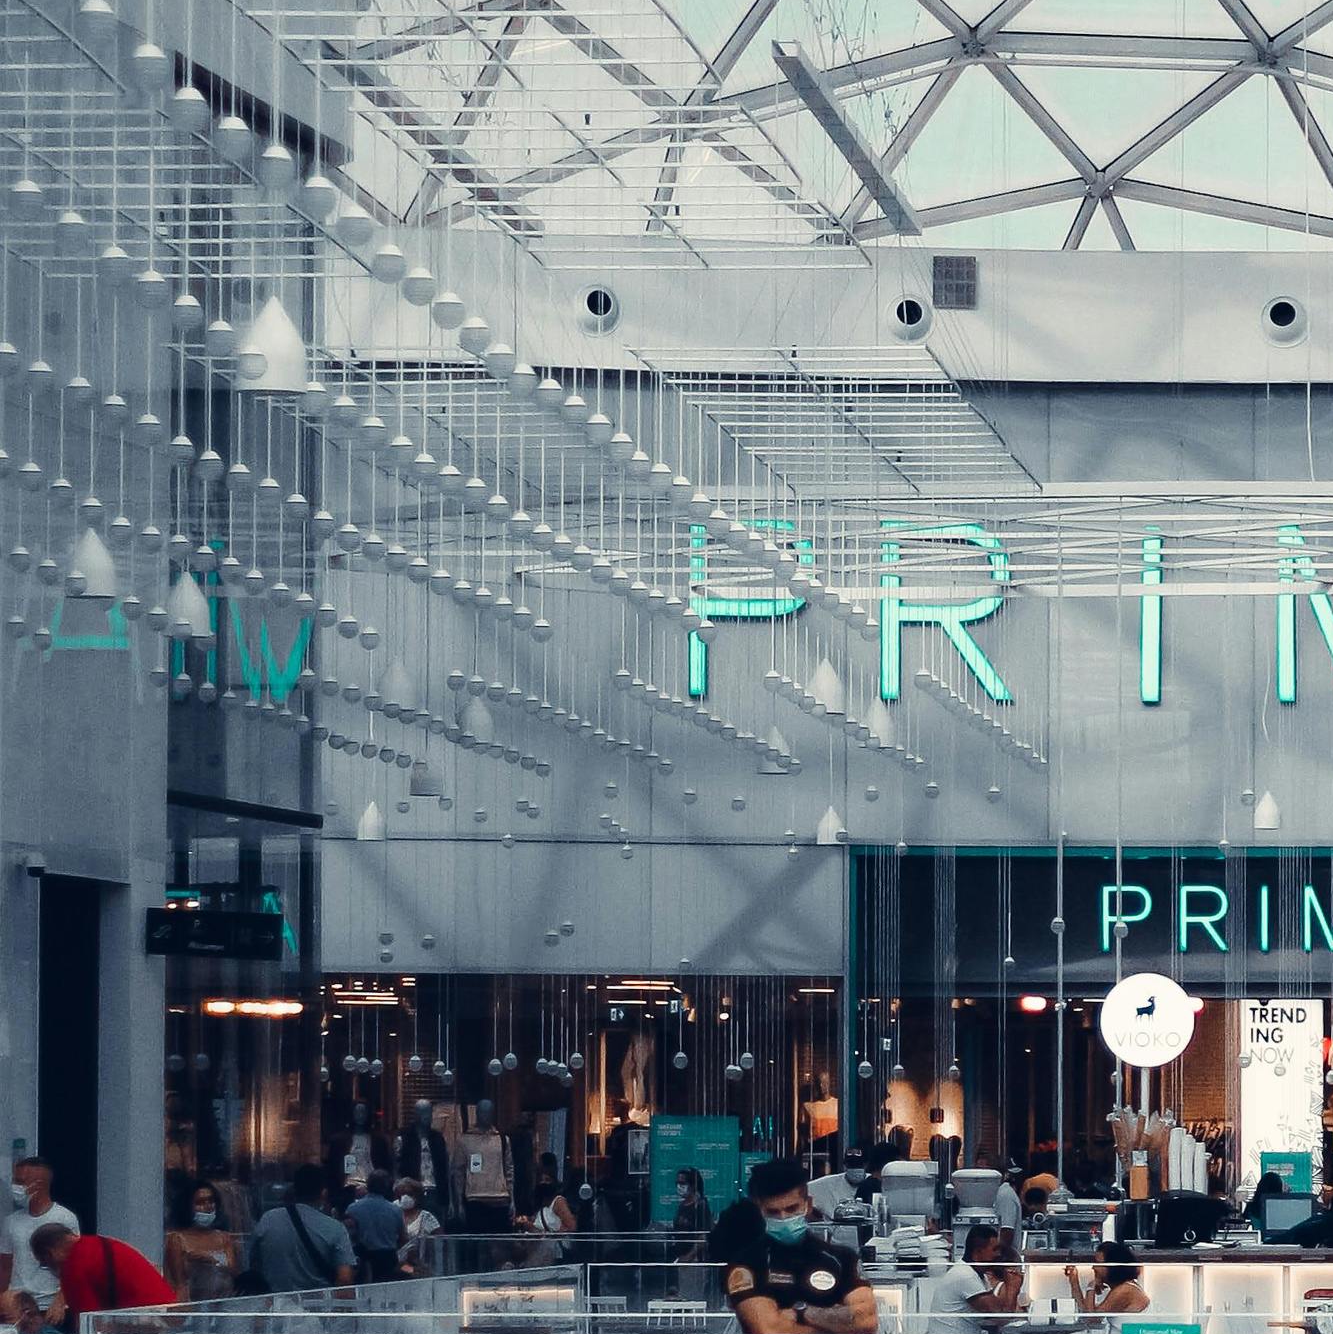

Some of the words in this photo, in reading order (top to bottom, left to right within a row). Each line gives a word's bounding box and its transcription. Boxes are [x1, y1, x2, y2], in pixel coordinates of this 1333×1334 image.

[1249, 1007, 1307, 1024] TREND
[1115, 1031, 1182, 1048] VIOKO
[1250, 1026, 1284, 1043] ING
[1250, 1046, 1295, 1065] NOW
